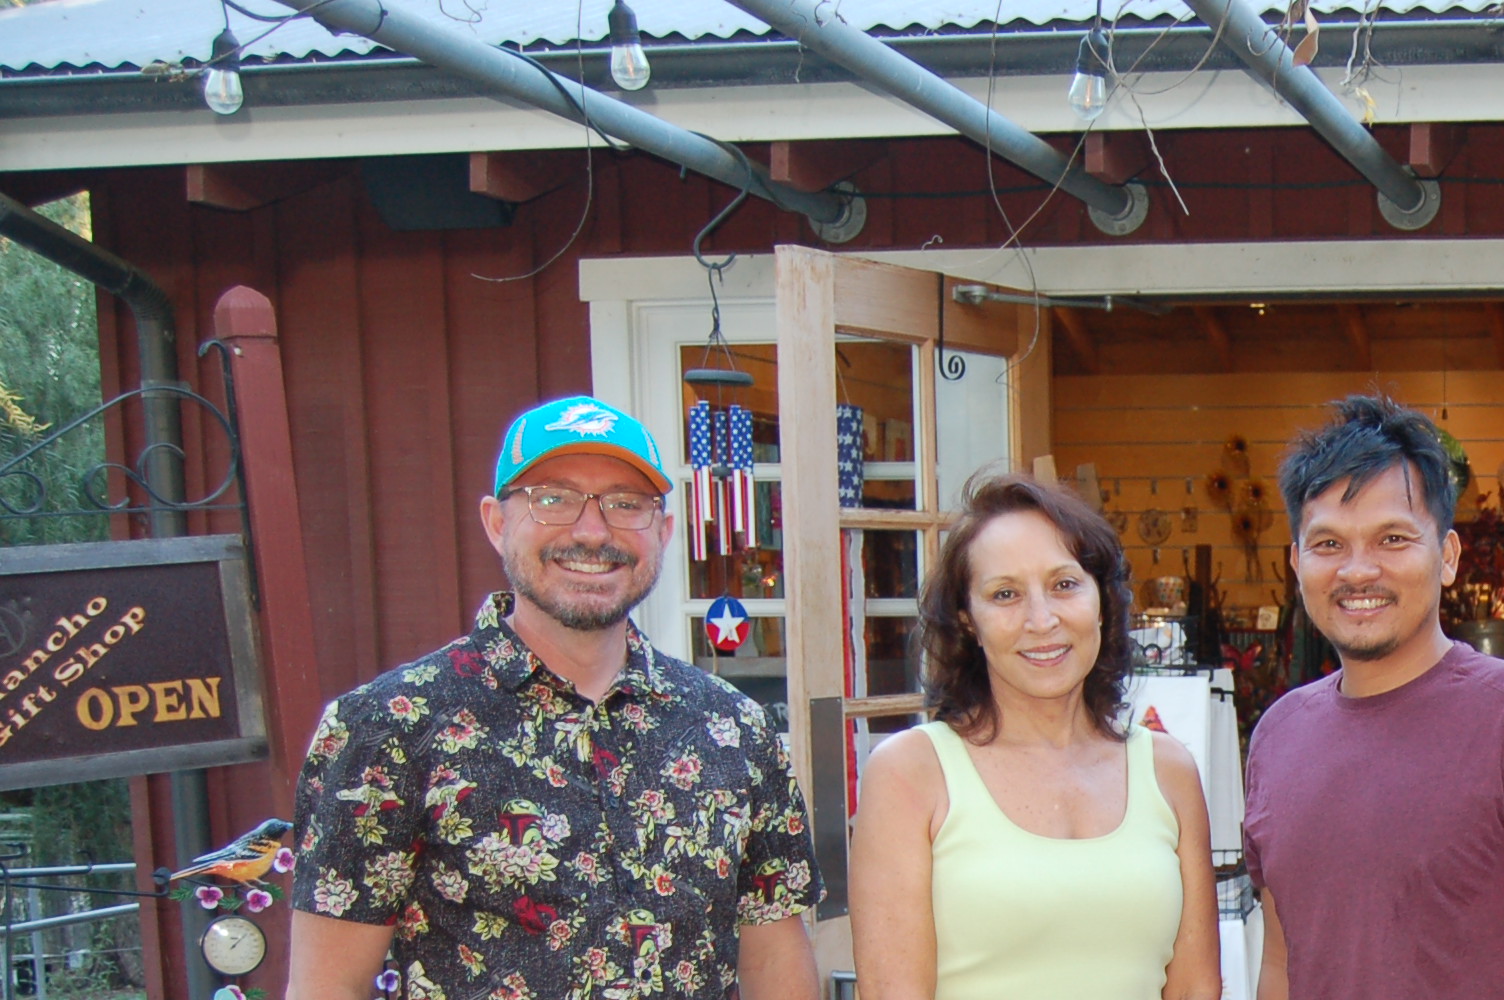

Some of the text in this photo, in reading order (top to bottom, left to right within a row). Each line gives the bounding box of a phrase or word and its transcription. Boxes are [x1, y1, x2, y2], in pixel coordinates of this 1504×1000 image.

[0, 596, 108, 700] ancho
[54, 604, 146, 688] Shop
[76, 677, 222, 731] OPEN
